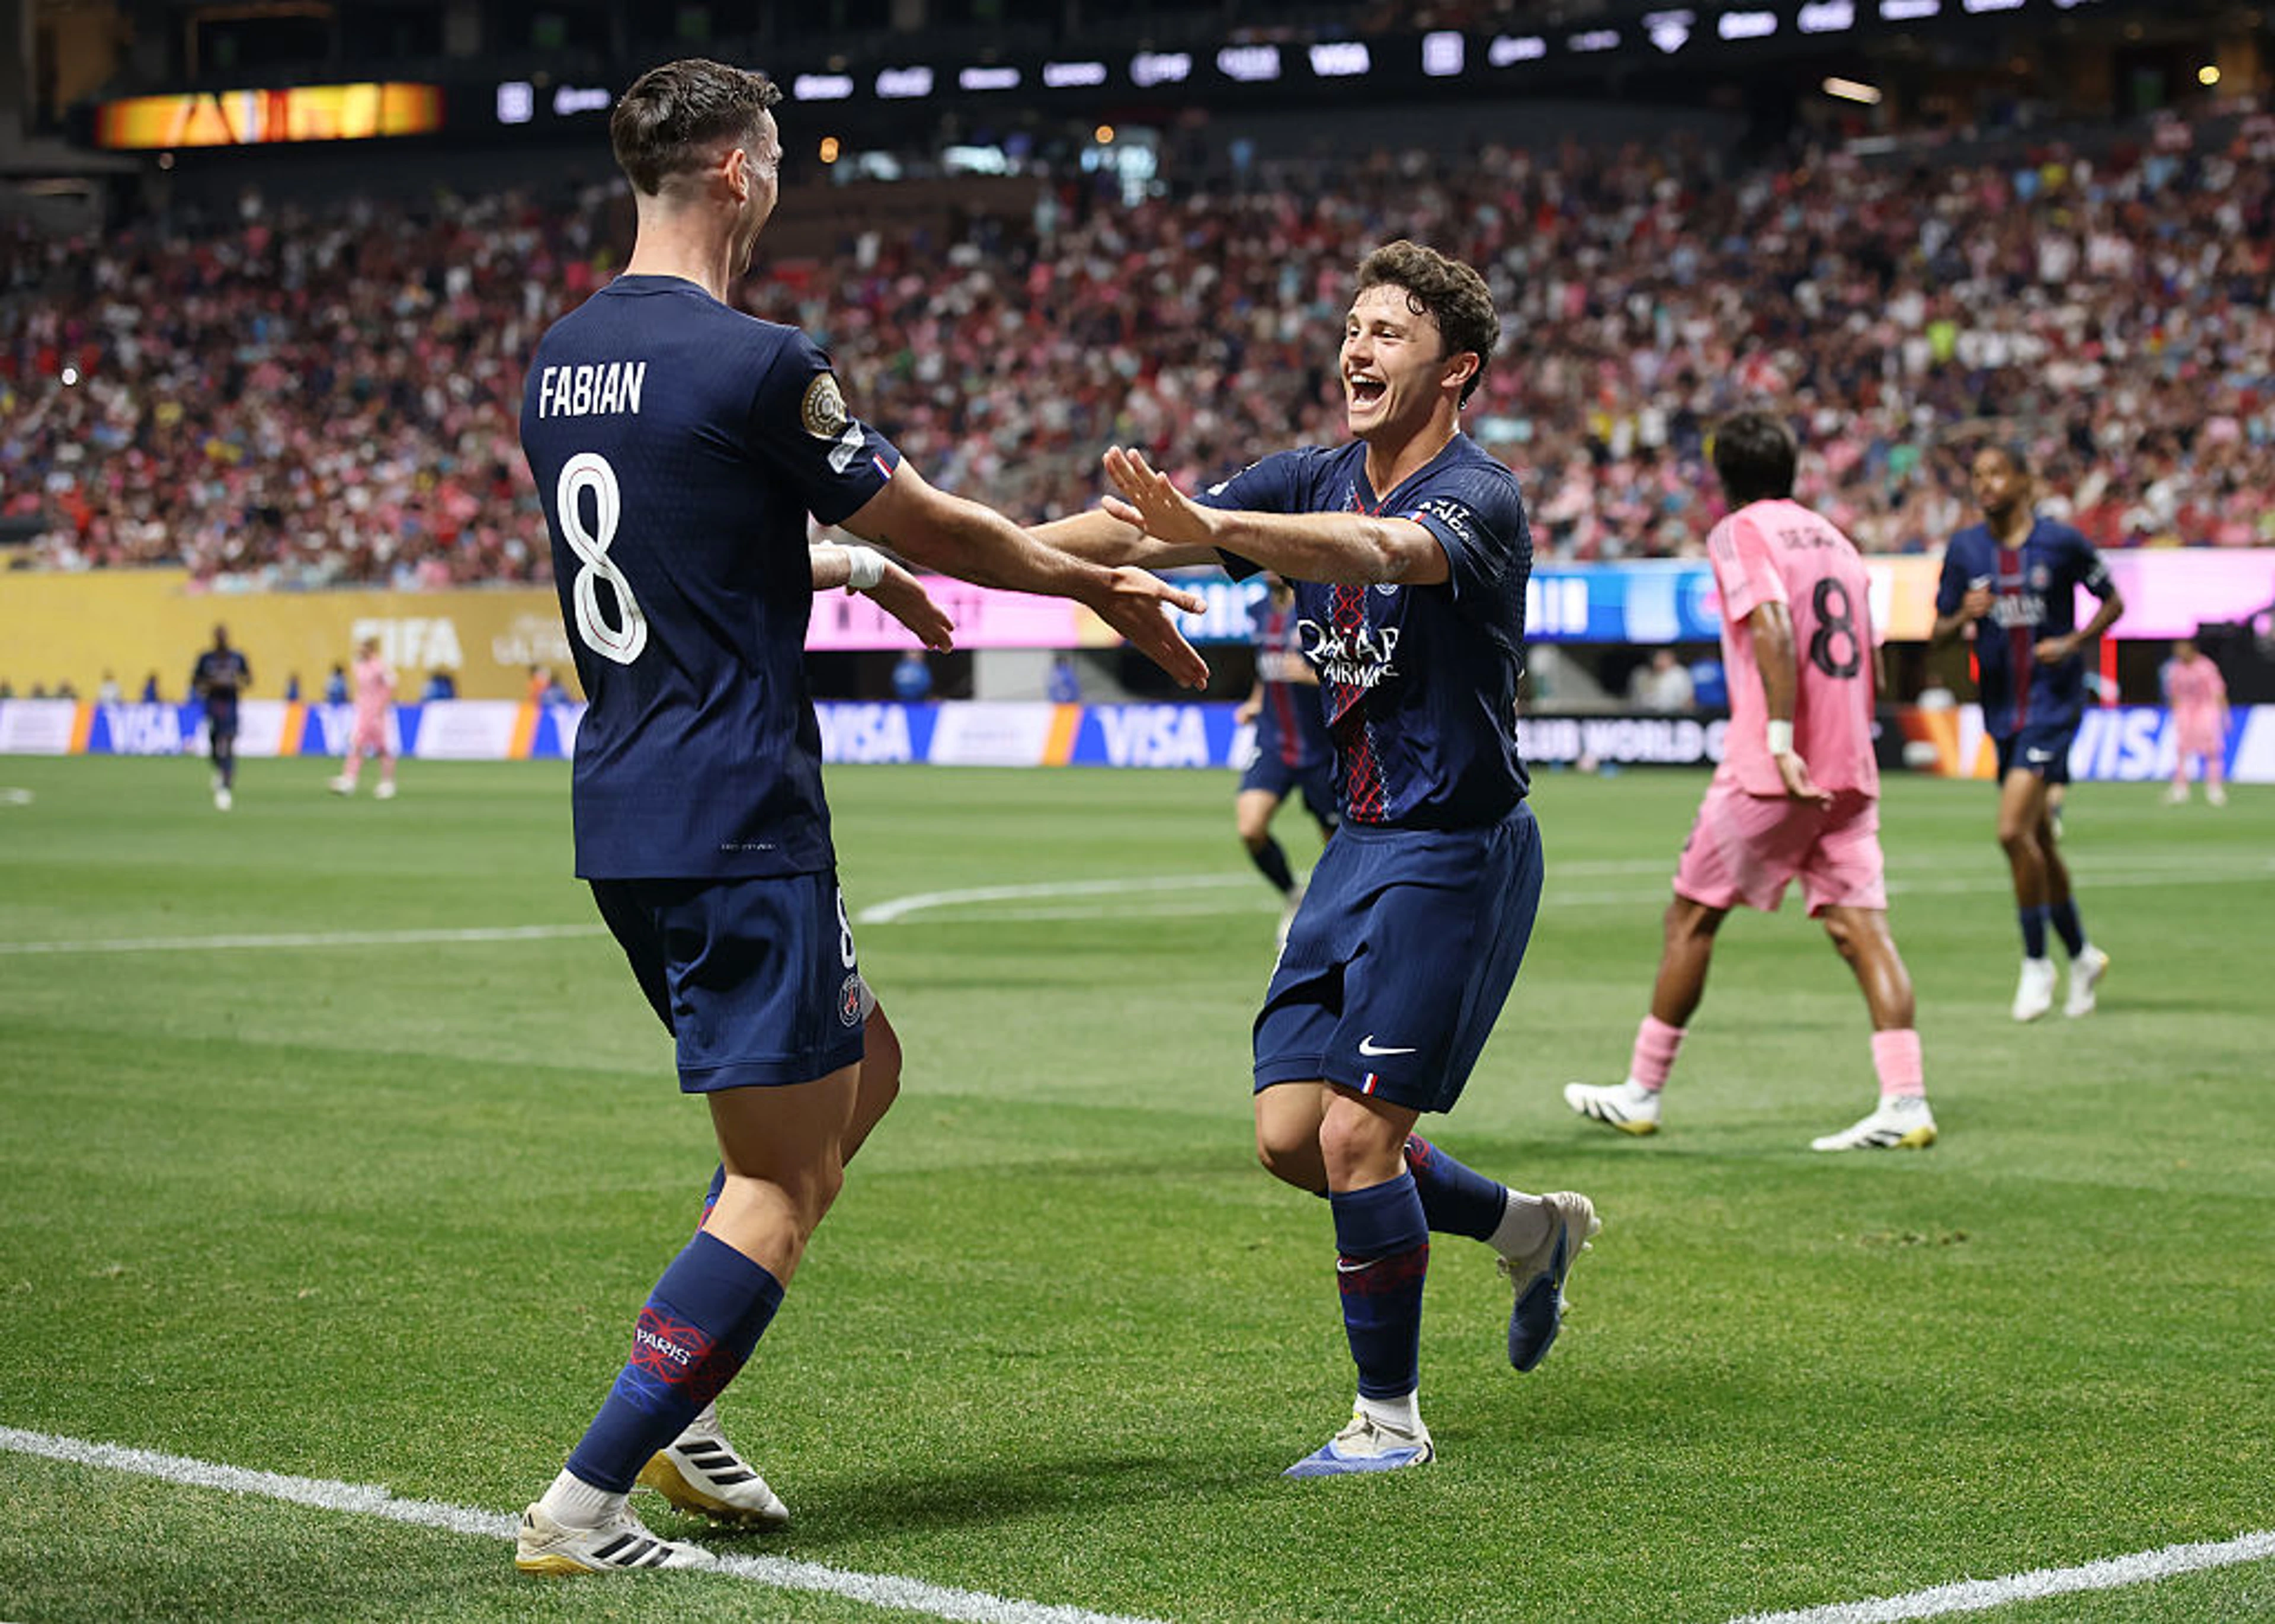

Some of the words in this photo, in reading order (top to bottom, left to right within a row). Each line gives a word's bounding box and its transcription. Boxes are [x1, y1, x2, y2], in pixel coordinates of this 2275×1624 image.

[540, 362, 647, 418] FABIAN
[557, 452, 648, 665] 8
[353, 617, 463, 670] FIFA
[1810, 576, 1861, 680] 8
[1095, 704, 1210, 768] VISA
[1517, 718, 1581, 760] LUB
[1583, 718, 1704, 763] WORLD
[637, 1327, 693, 1366] PARIS
